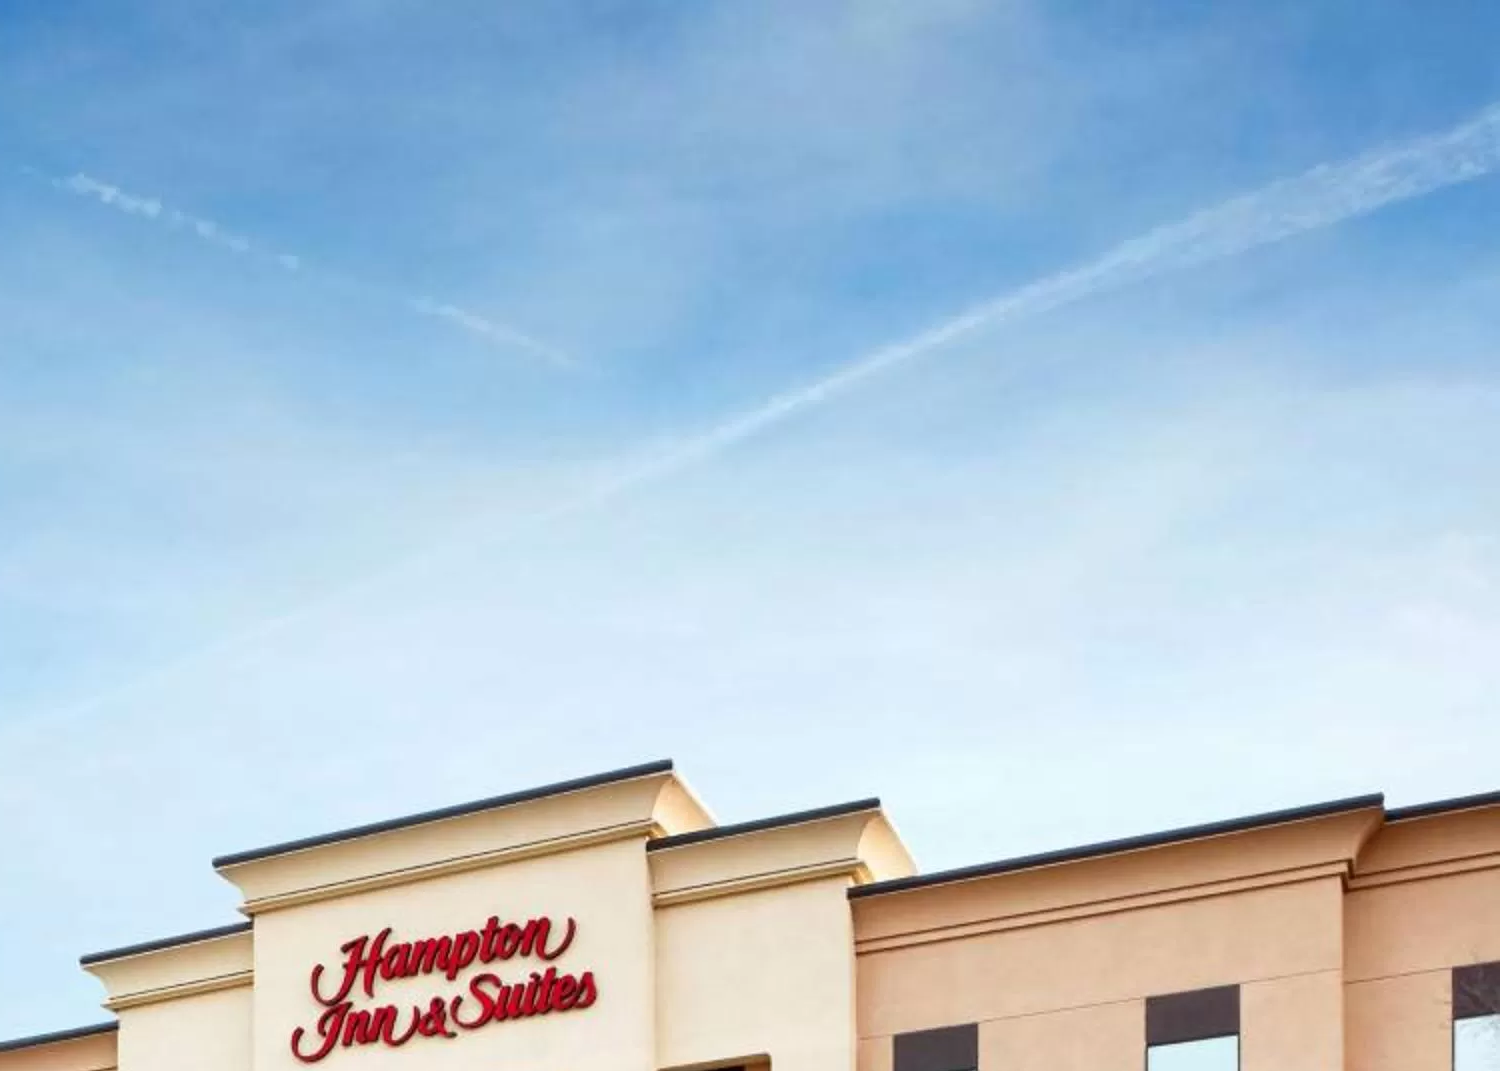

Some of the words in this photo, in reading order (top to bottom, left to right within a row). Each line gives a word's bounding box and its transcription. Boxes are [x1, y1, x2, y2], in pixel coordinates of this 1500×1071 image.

[311, 915, 576, 1006] Hampton
[291, 1002, 420, 1063] Inn
[417, 997, 458, 1039] &
[450, 967, 597, 1030] Suites
